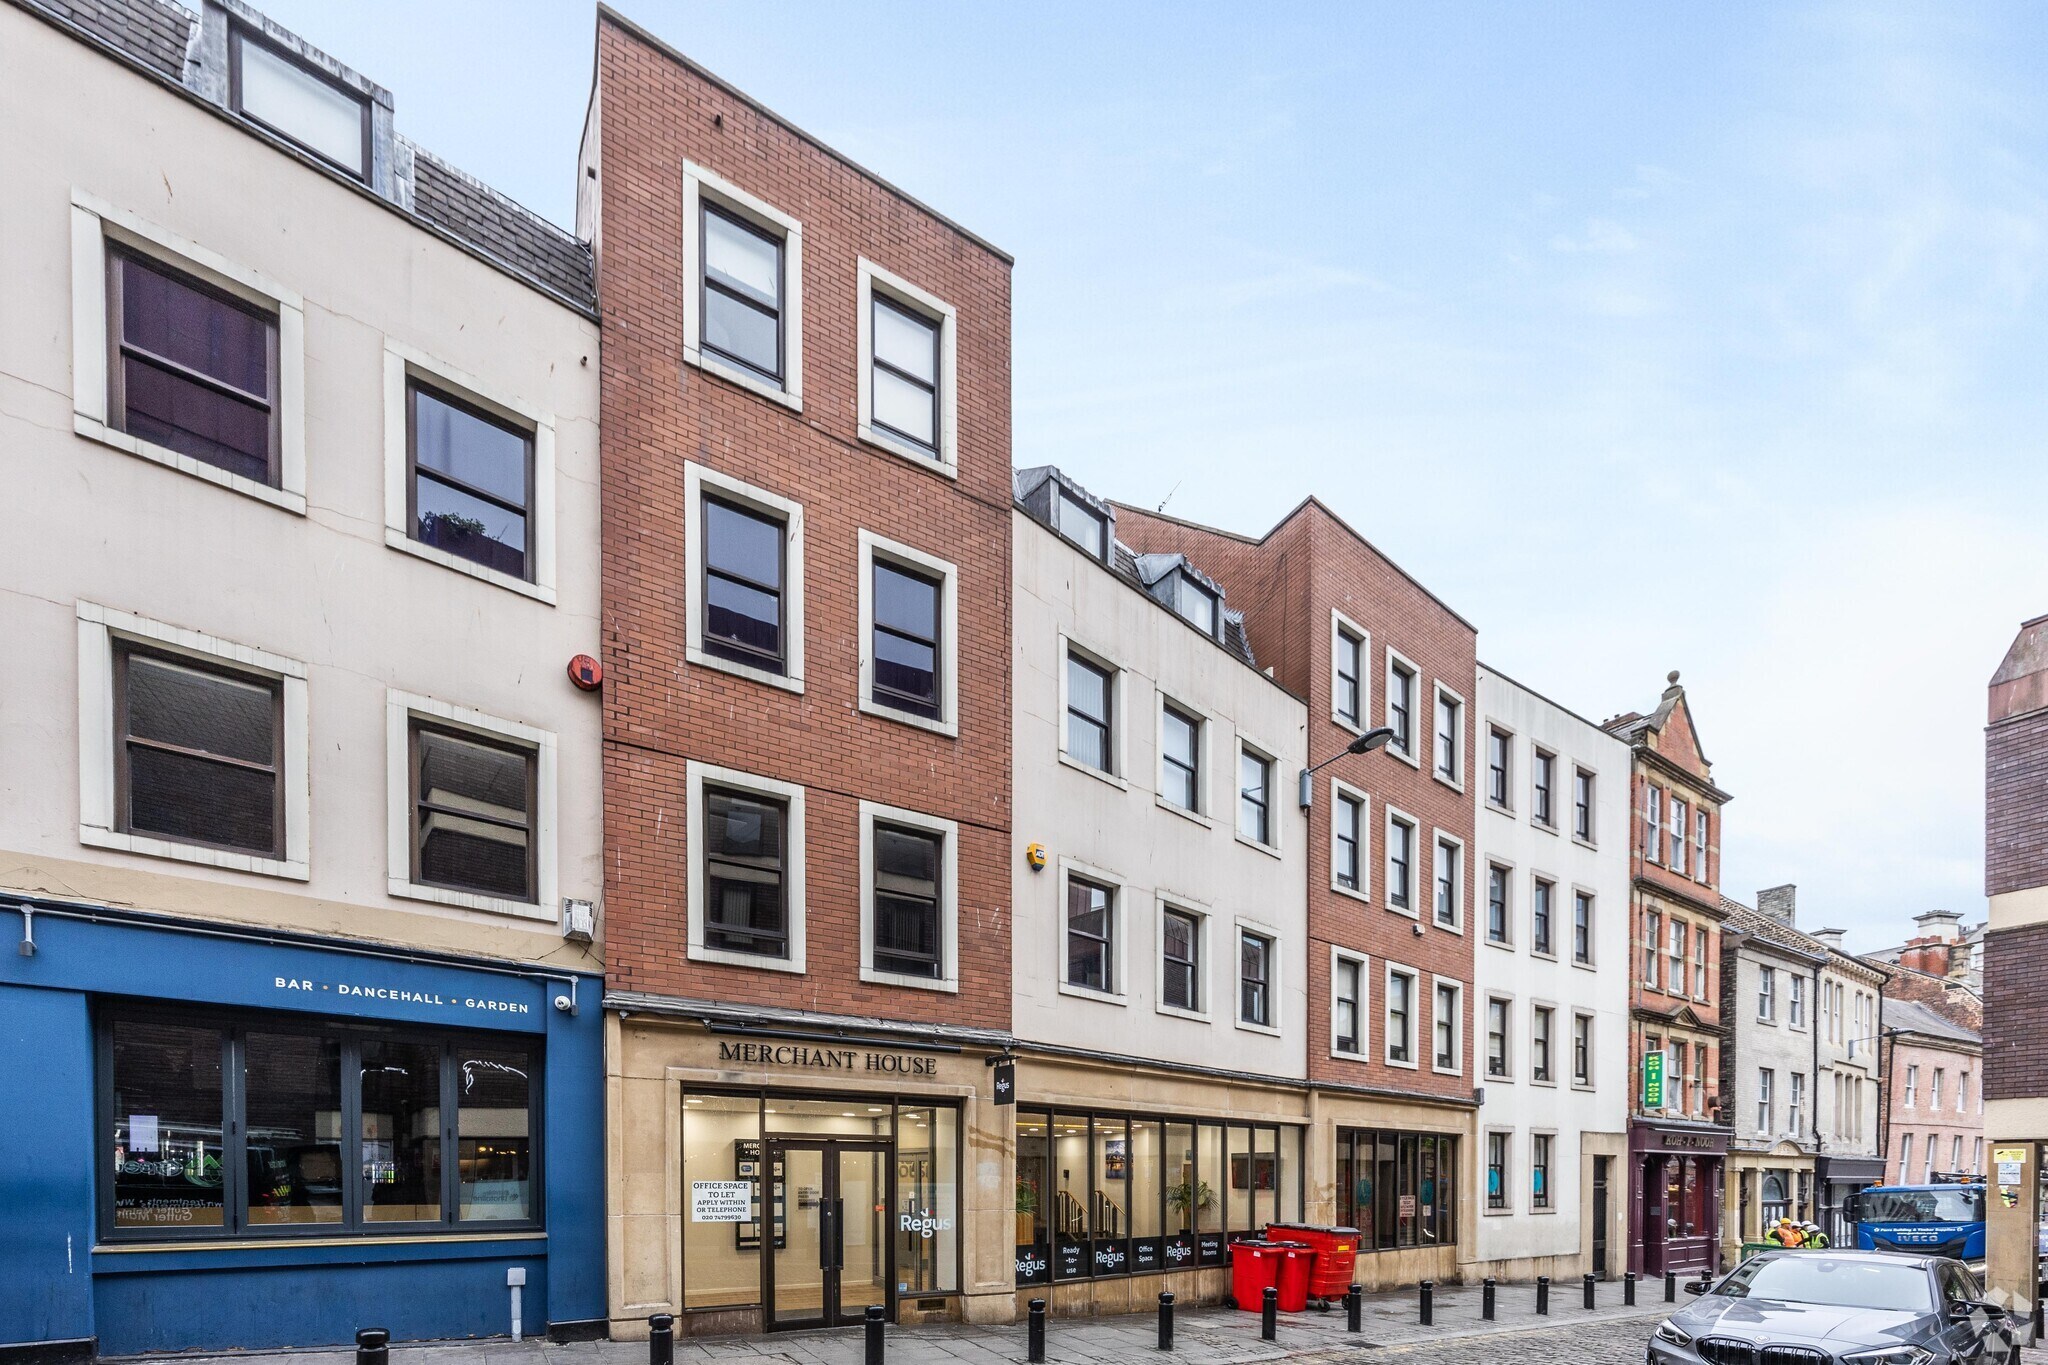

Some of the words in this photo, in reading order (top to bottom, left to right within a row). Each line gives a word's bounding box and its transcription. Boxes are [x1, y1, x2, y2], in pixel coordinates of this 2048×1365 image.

[275, 977, 313, 991] BAR
[338, 984, 443, 1005] DANCEHALL
[465, 998, 529, 1014] GARDEN
[719, 1042, 857, 1069] MERCHANT
[866, 1053, 938, 1075] HOUSE
[1648, 1056, 1660, 1071] KOH
[996, 1081, 1010, 1093] Regus
[1648, 1082, 1660, 1102] NOOR
[693, 1182, 722, 1190] OFFICE
[900, 1214, 952, 1239] Regus
[1062, 1246, 1080, 1255] Ready
[1166, 1246, 1192, 1261] Regus
[1095, 1251, 1125, 1268] Regus
[1138, 1255, 1153, 1263] Space
[1016, 1259, 1046, 1277] Regus
